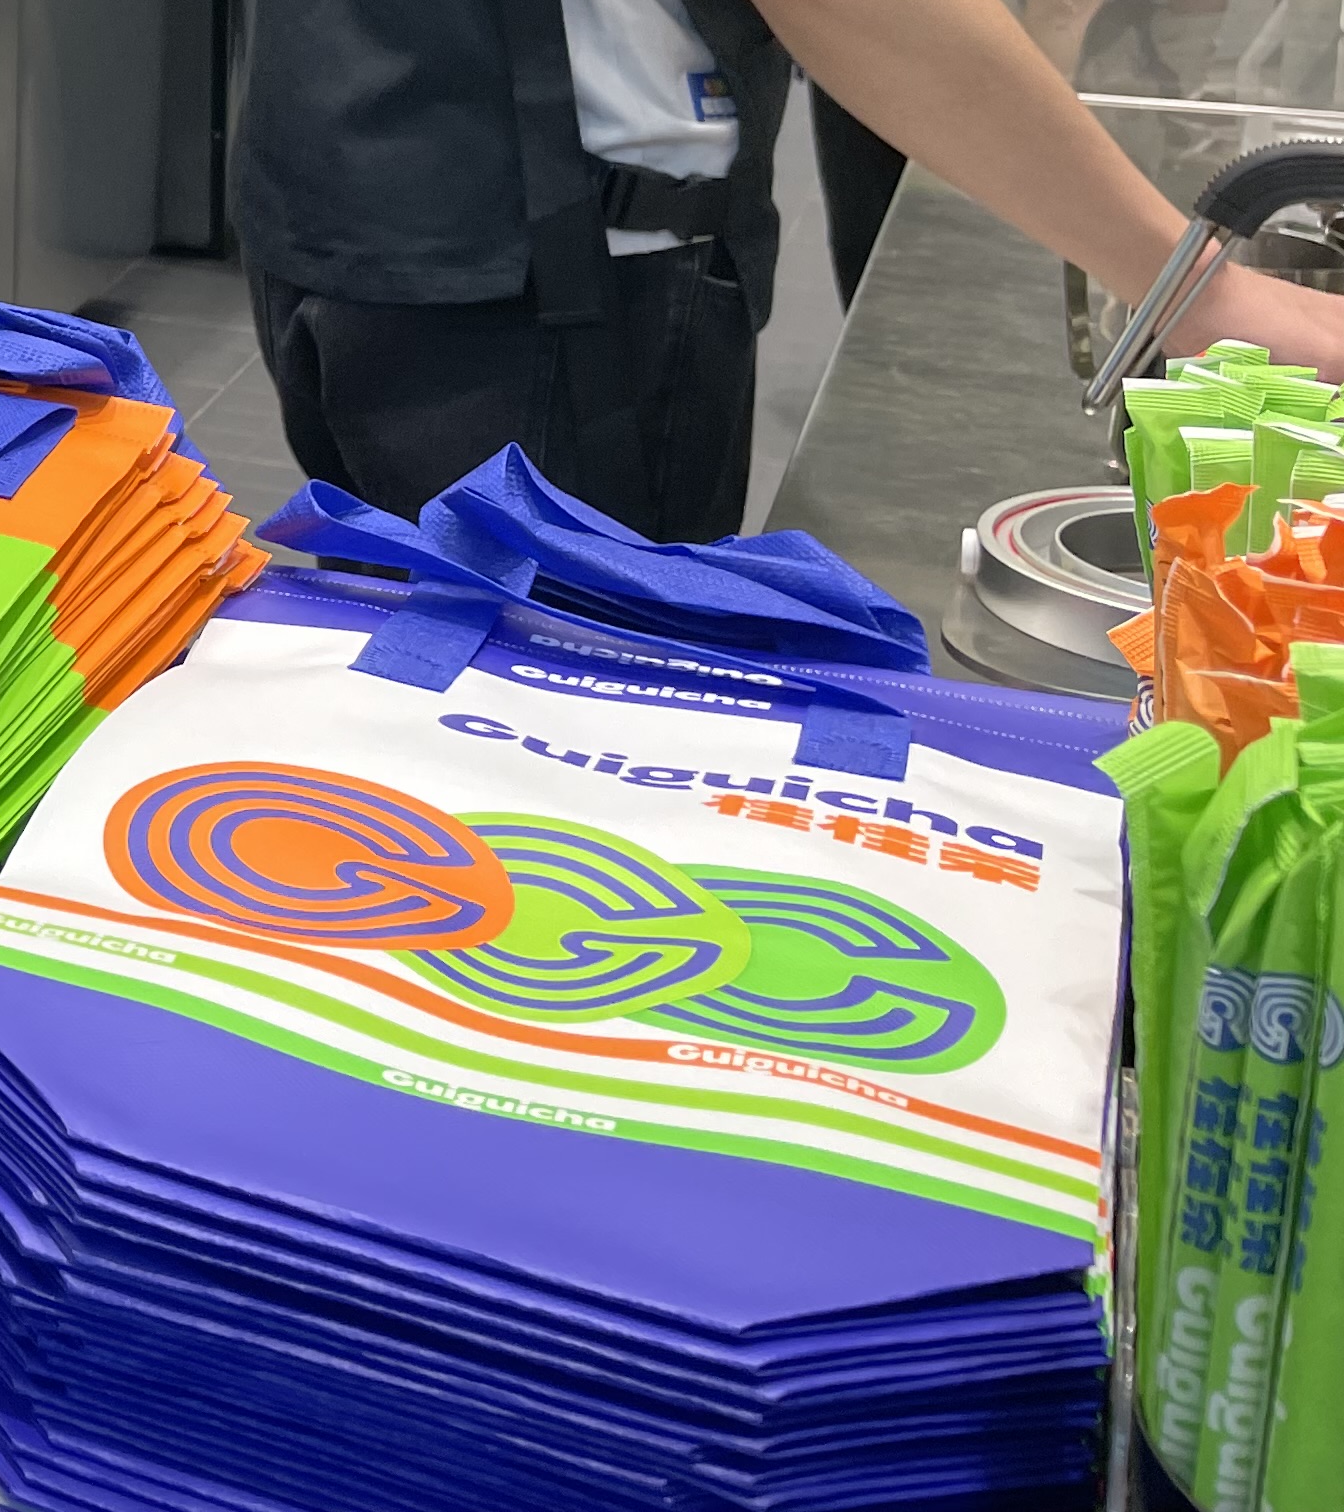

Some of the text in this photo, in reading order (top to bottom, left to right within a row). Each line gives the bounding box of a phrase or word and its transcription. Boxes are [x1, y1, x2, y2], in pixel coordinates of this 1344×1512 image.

[511, 664, 772, 711] Guiguicha
[438, 713, 1044, 861] Guiguicha
[701, 792, 1041, 892] 桂桂茶
[381, 1069, 617, 1132] Guiguicha
[667, 1043, 909, 1109] Guiguicha
